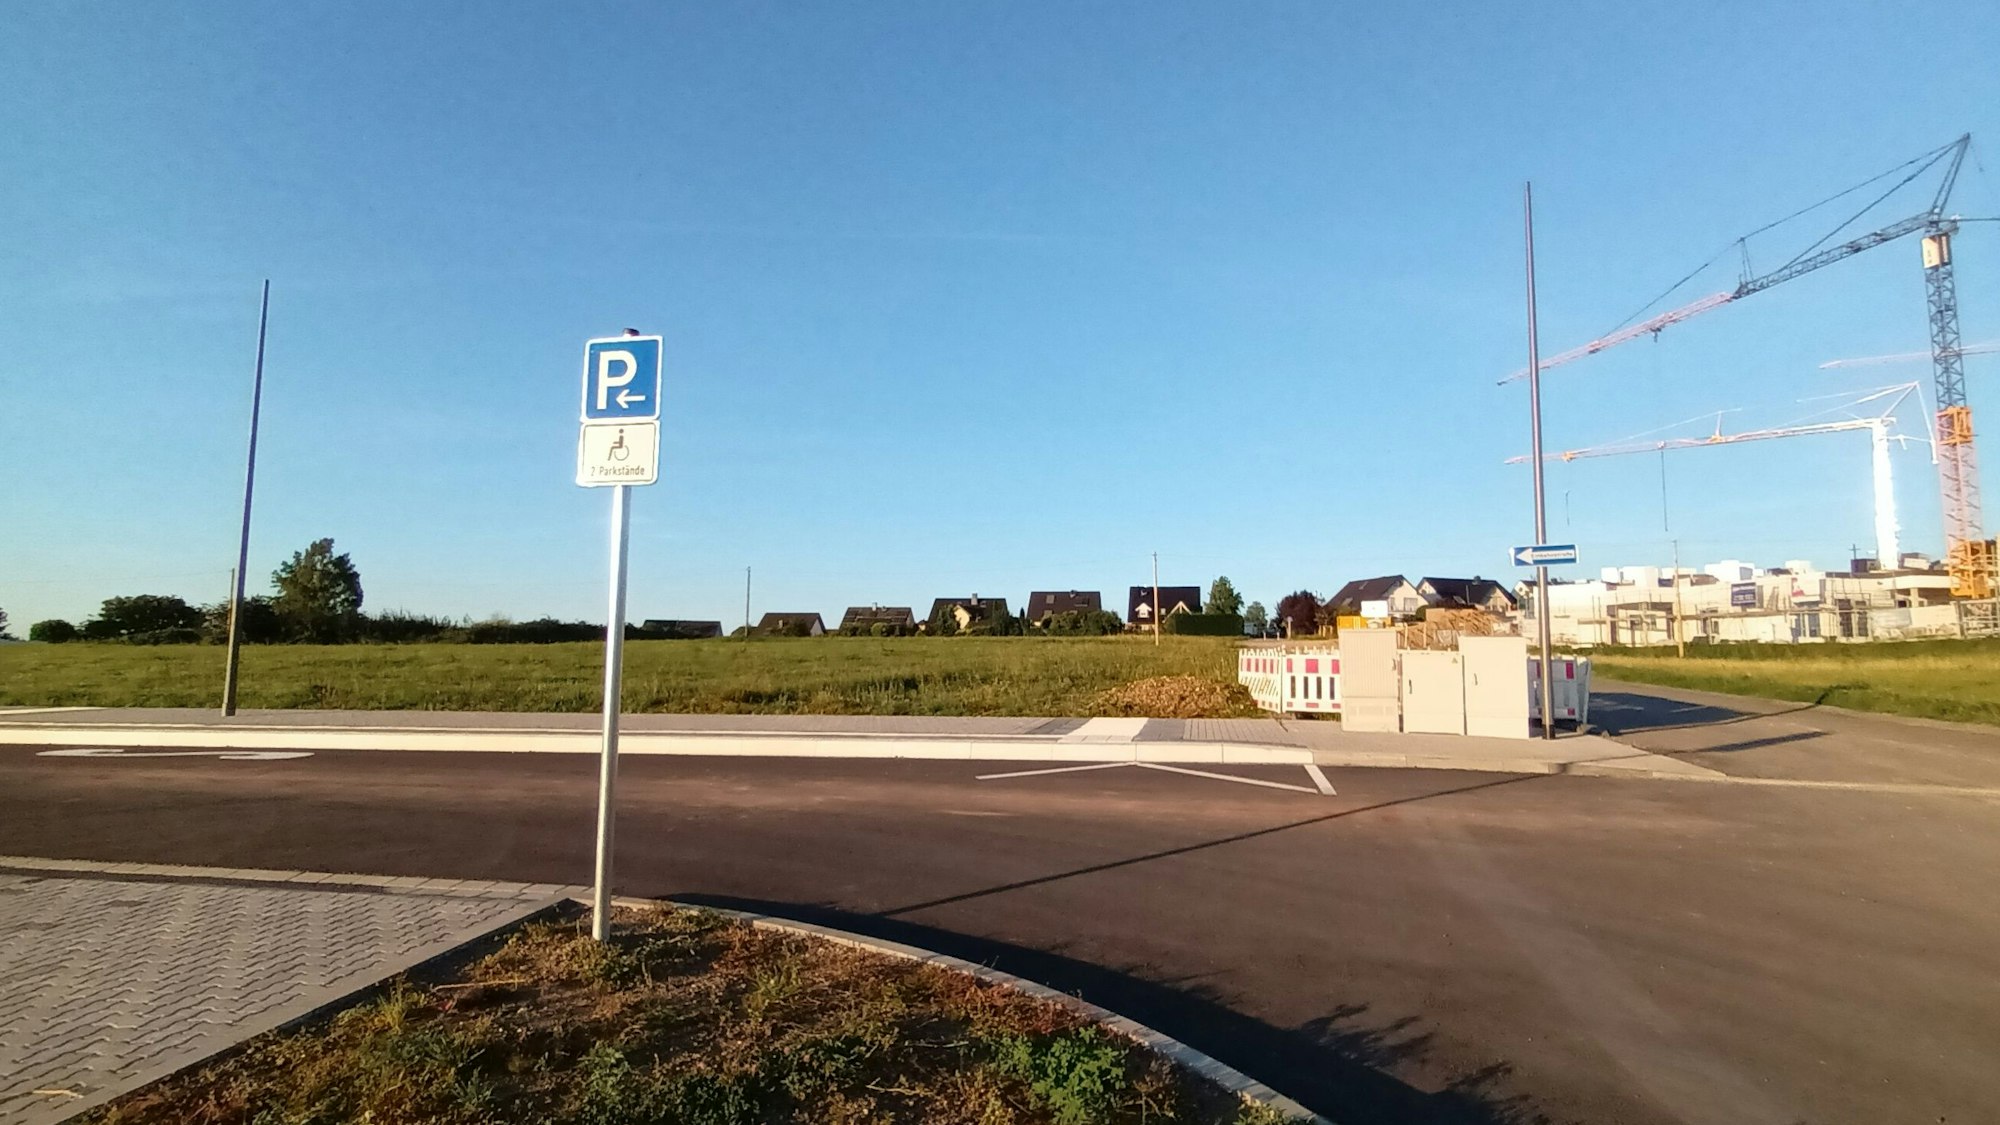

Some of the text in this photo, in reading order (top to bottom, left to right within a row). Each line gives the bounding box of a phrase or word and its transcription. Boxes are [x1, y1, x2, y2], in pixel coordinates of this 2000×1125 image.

[596, 350, 638, 410] P
[590, 465, 645, 477] 2 Parkstände
